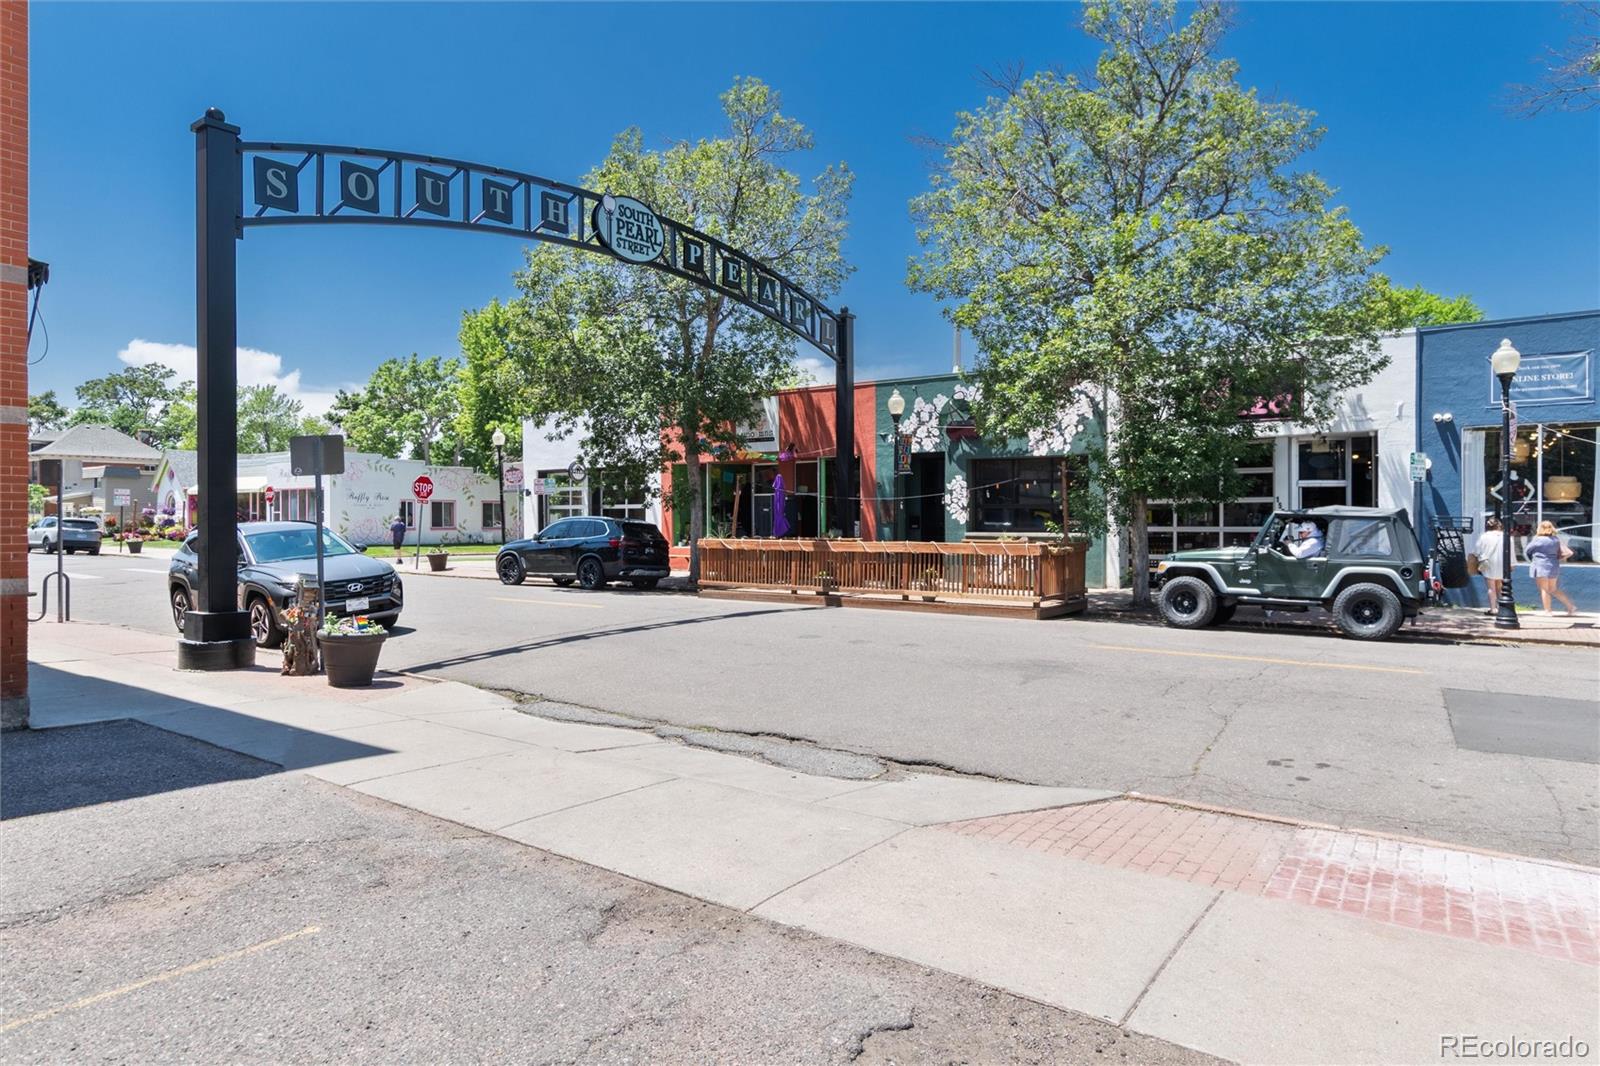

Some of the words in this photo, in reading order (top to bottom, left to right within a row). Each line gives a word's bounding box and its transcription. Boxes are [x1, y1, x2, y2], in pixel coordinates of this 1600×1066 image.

[265, 167, 566, 225] SOUTH
[618, 204, 654, 227] SOUTH
[616, 218, 662, 252] PEARL
[616, 237, 650, 256] STREET
[1512, 374, 1540, 382] NLINE
[1541, 372, 1574, 381] STORE!
[414, 482, 433, 493] STOP
